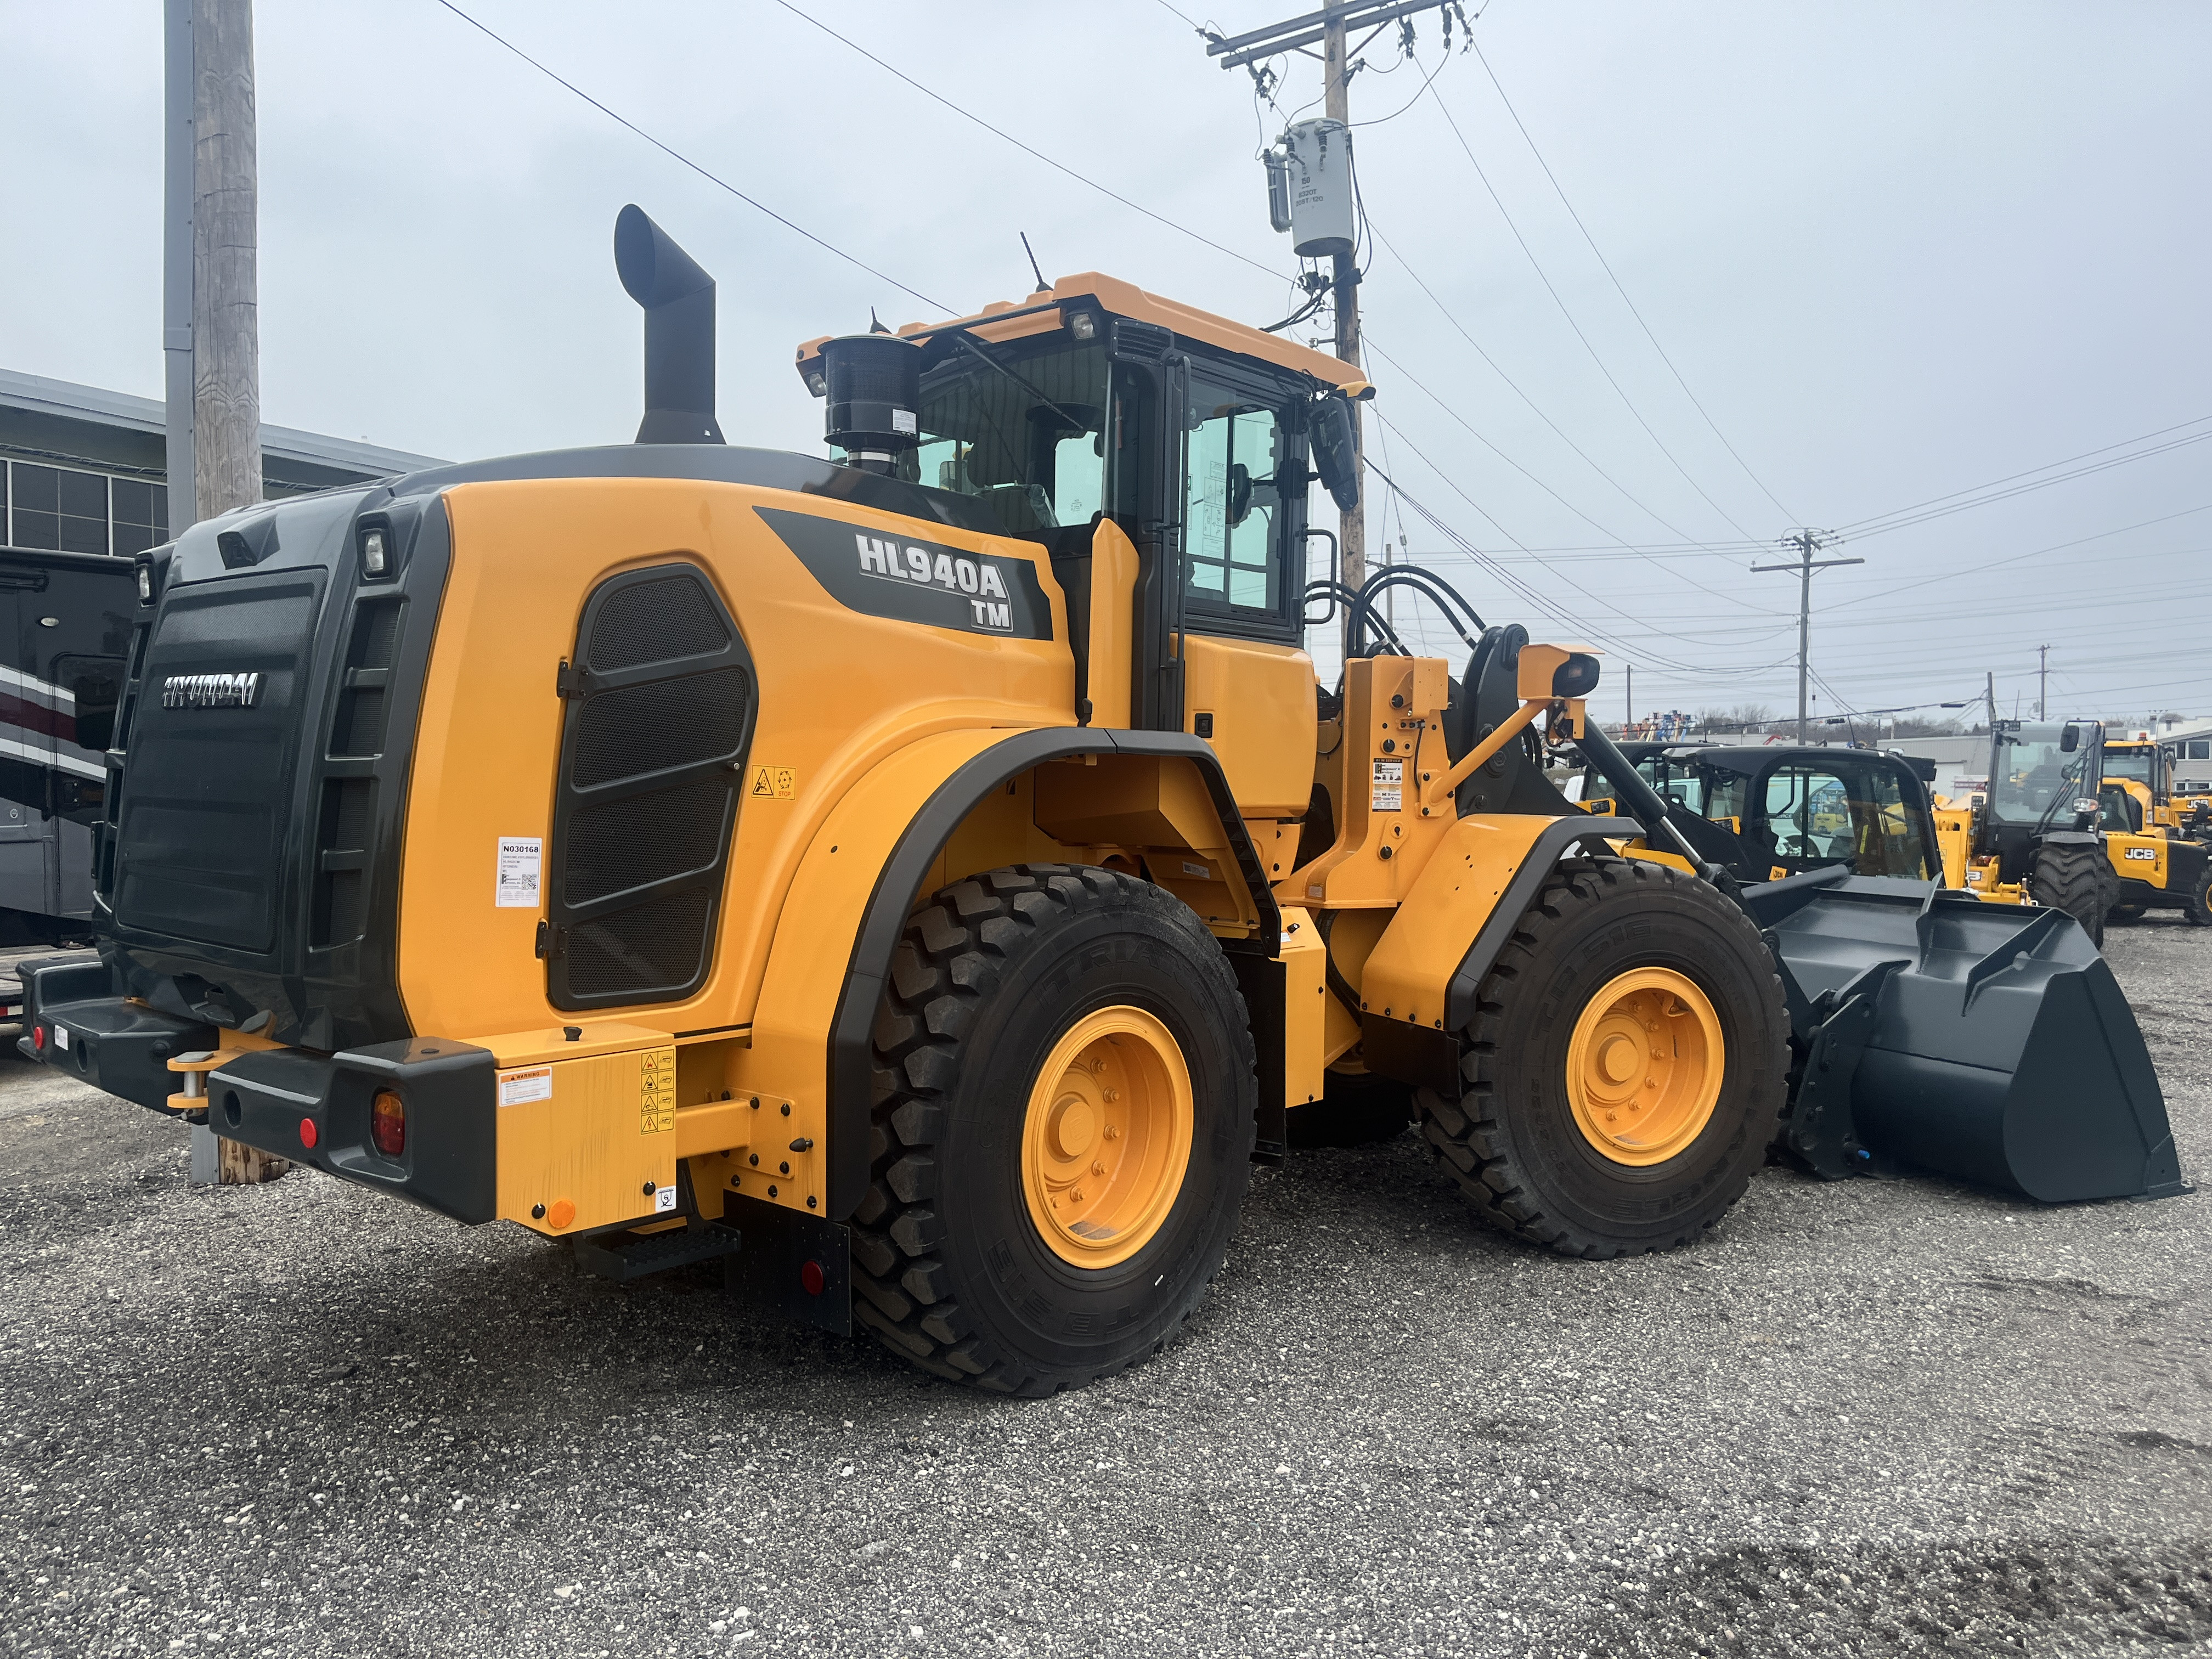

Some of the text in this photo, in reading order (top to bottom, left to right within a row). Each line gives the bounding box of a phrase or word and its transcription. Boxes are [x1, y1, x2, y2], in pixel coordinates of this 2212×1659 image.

[855, 534, 1007, 599] HL940A
[971, 600, 1010, 628] TM
[2125, 848, 2154, 860] JCB
